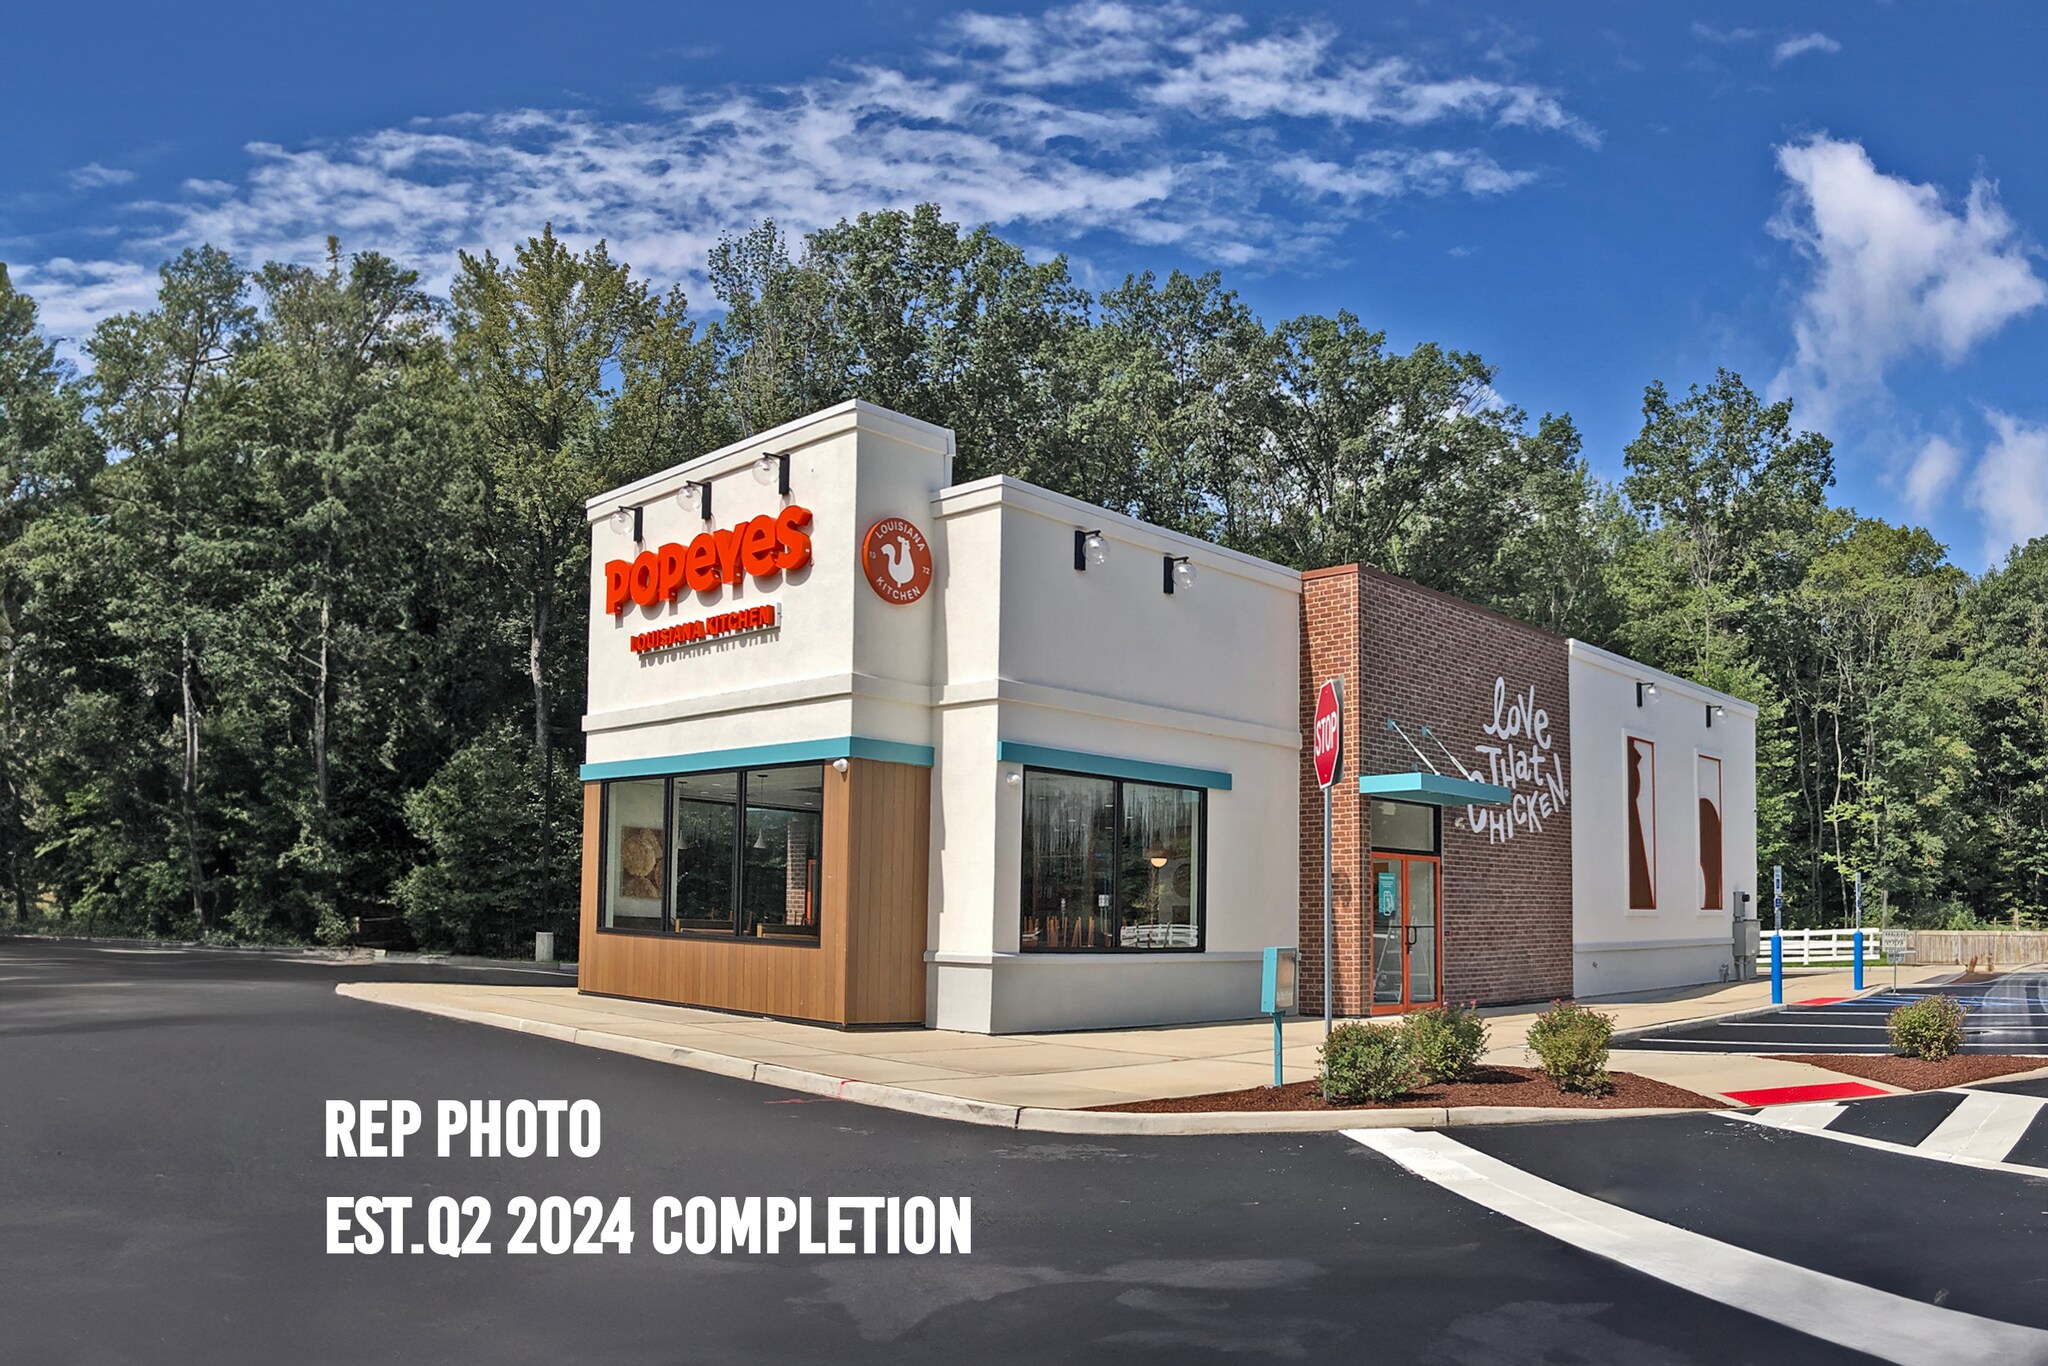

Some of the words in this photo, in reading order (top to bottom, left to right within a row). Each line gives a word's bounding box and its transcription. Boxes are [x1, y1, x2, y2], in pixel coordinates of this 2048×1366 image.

[875, 521, 925, 552] LOUISIANA
[922, 566, 930, 575] 72
[876, 576, 921, 601] KITCHEN
[630, 619, 706, 653] LOUISIANA
[705, 604, 775, 635] KITCHEN
[1315, 711, 1337, 757] STOP
